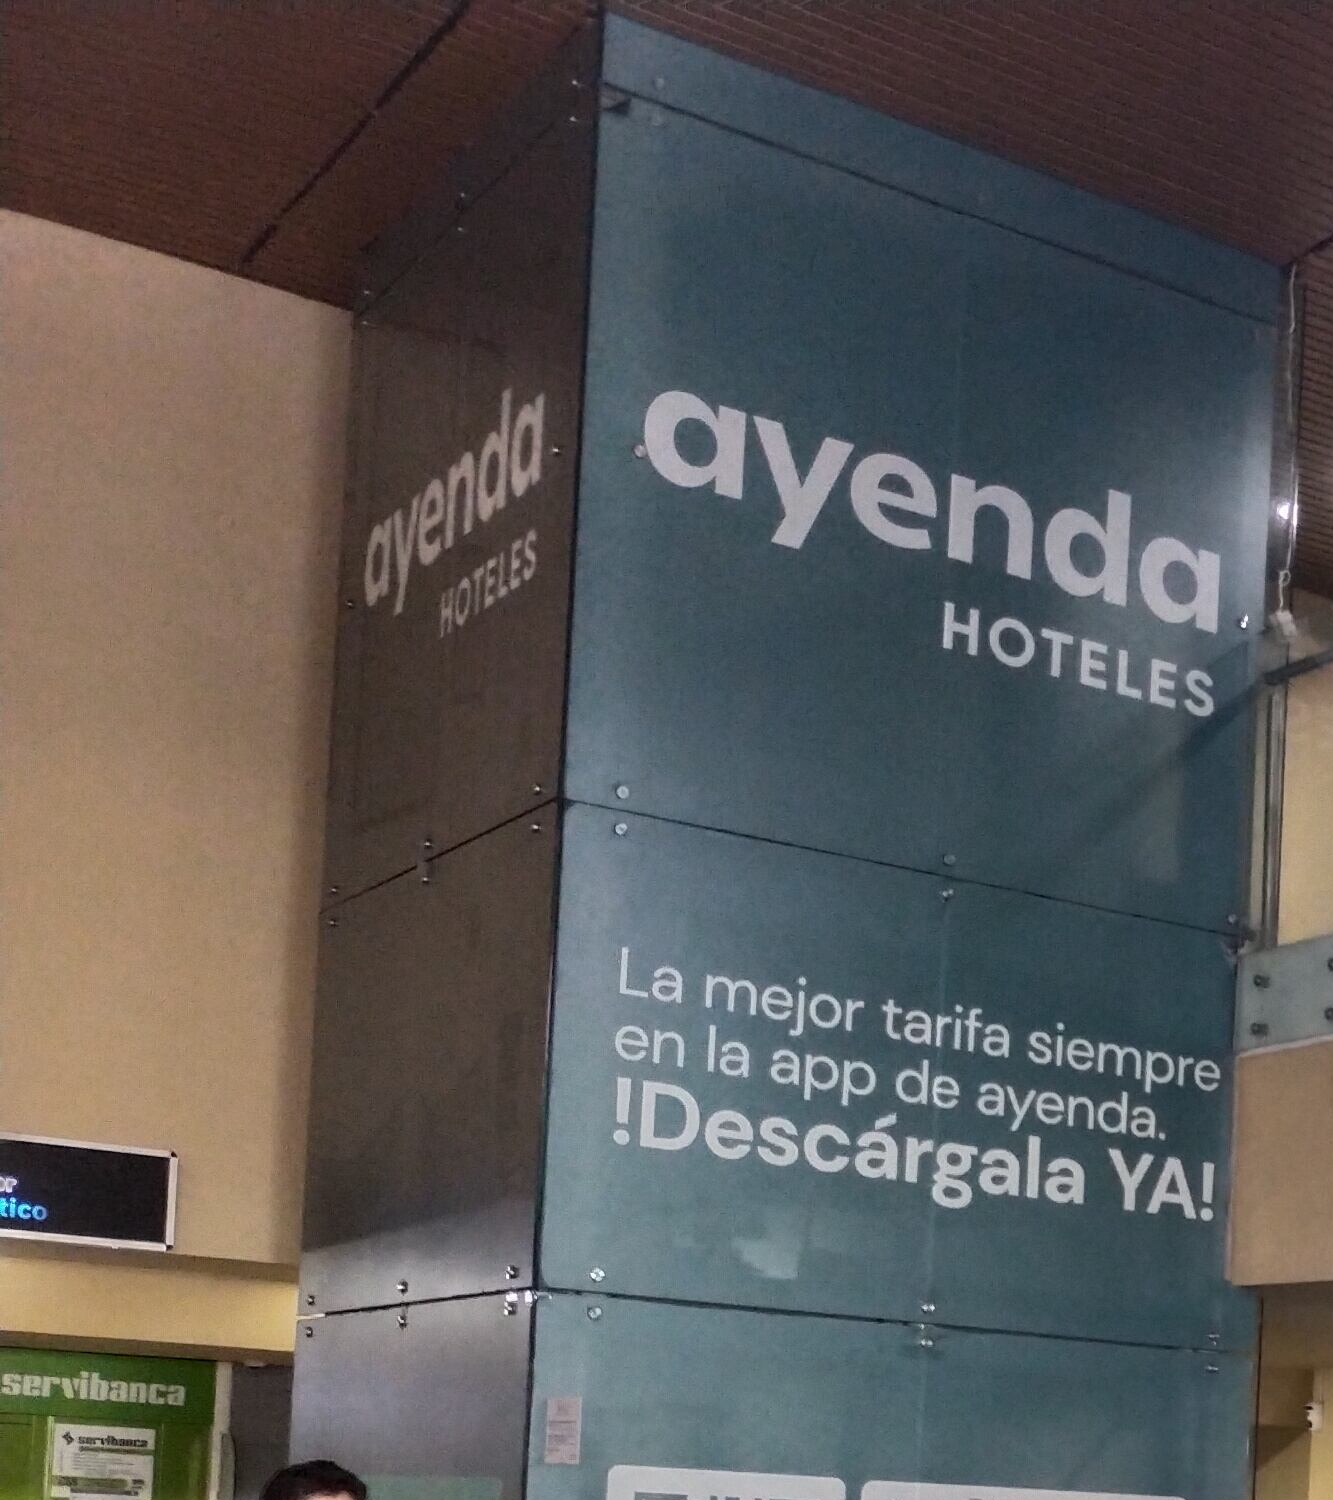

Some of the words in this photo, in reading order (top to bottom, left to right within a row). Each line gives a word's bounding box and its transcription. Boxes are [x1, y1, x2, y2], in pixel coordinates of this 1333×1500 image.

[364, 388, 545, 615] ayenda
[644, 391, 1220, 634] ayenda
[439, 529, 537, 638] HOTELES
[942, 602, 1214, 716] HOTELES
[620, 947, 682, 1003] La
[705, 976, 864, 1036] mejor
[883, 1000, 1009, 1059] tarifa
[1027, 1022, 1220, 1093] siempre
[615, 1024, 684, 1067] en
[708, 1025, 749, 1078] la
[771, 1050, 876, 1106] app
[896, 1060, 959, 1109] de
[978, 1083, 1166, 1141] ayenda.
[613, 1077, 1084, 1209] !Descárgala
[1108, 1147, 1216, 1222] YA!
[1, 1370, 186, 1406] servibanca
[78, 1434, 148, 1448] servibanca
